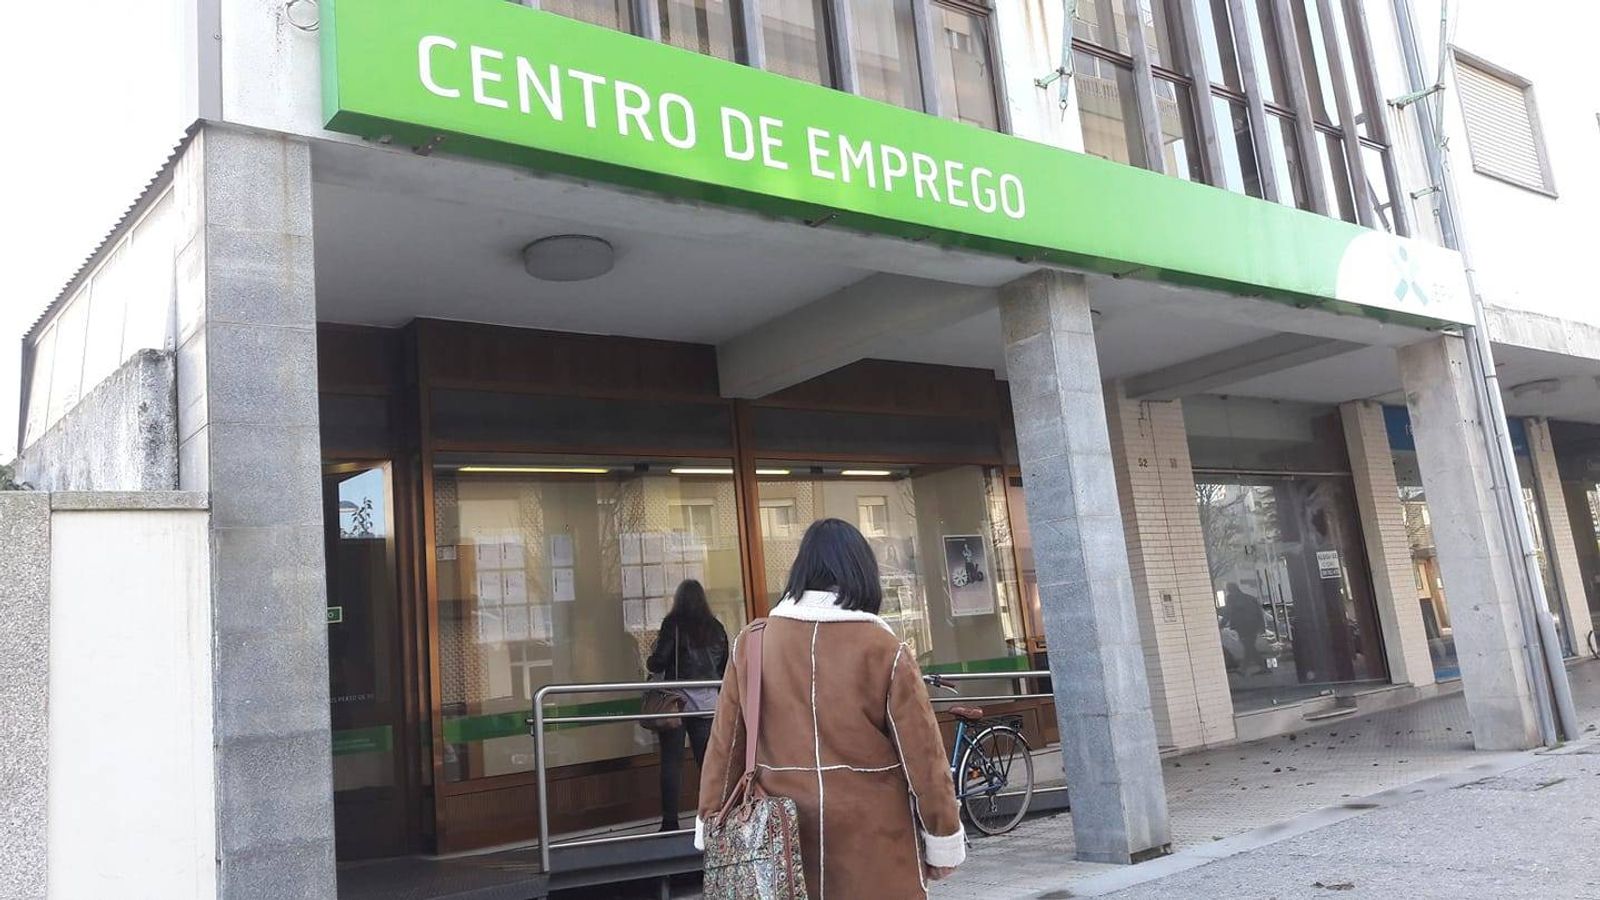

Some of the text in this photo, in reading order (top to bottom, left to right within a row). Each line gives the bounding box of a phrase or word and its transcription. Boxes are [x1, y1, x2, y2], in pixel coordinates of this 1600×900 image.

[418, 35, 1026, 220] CENTRO DE EMPREGO
